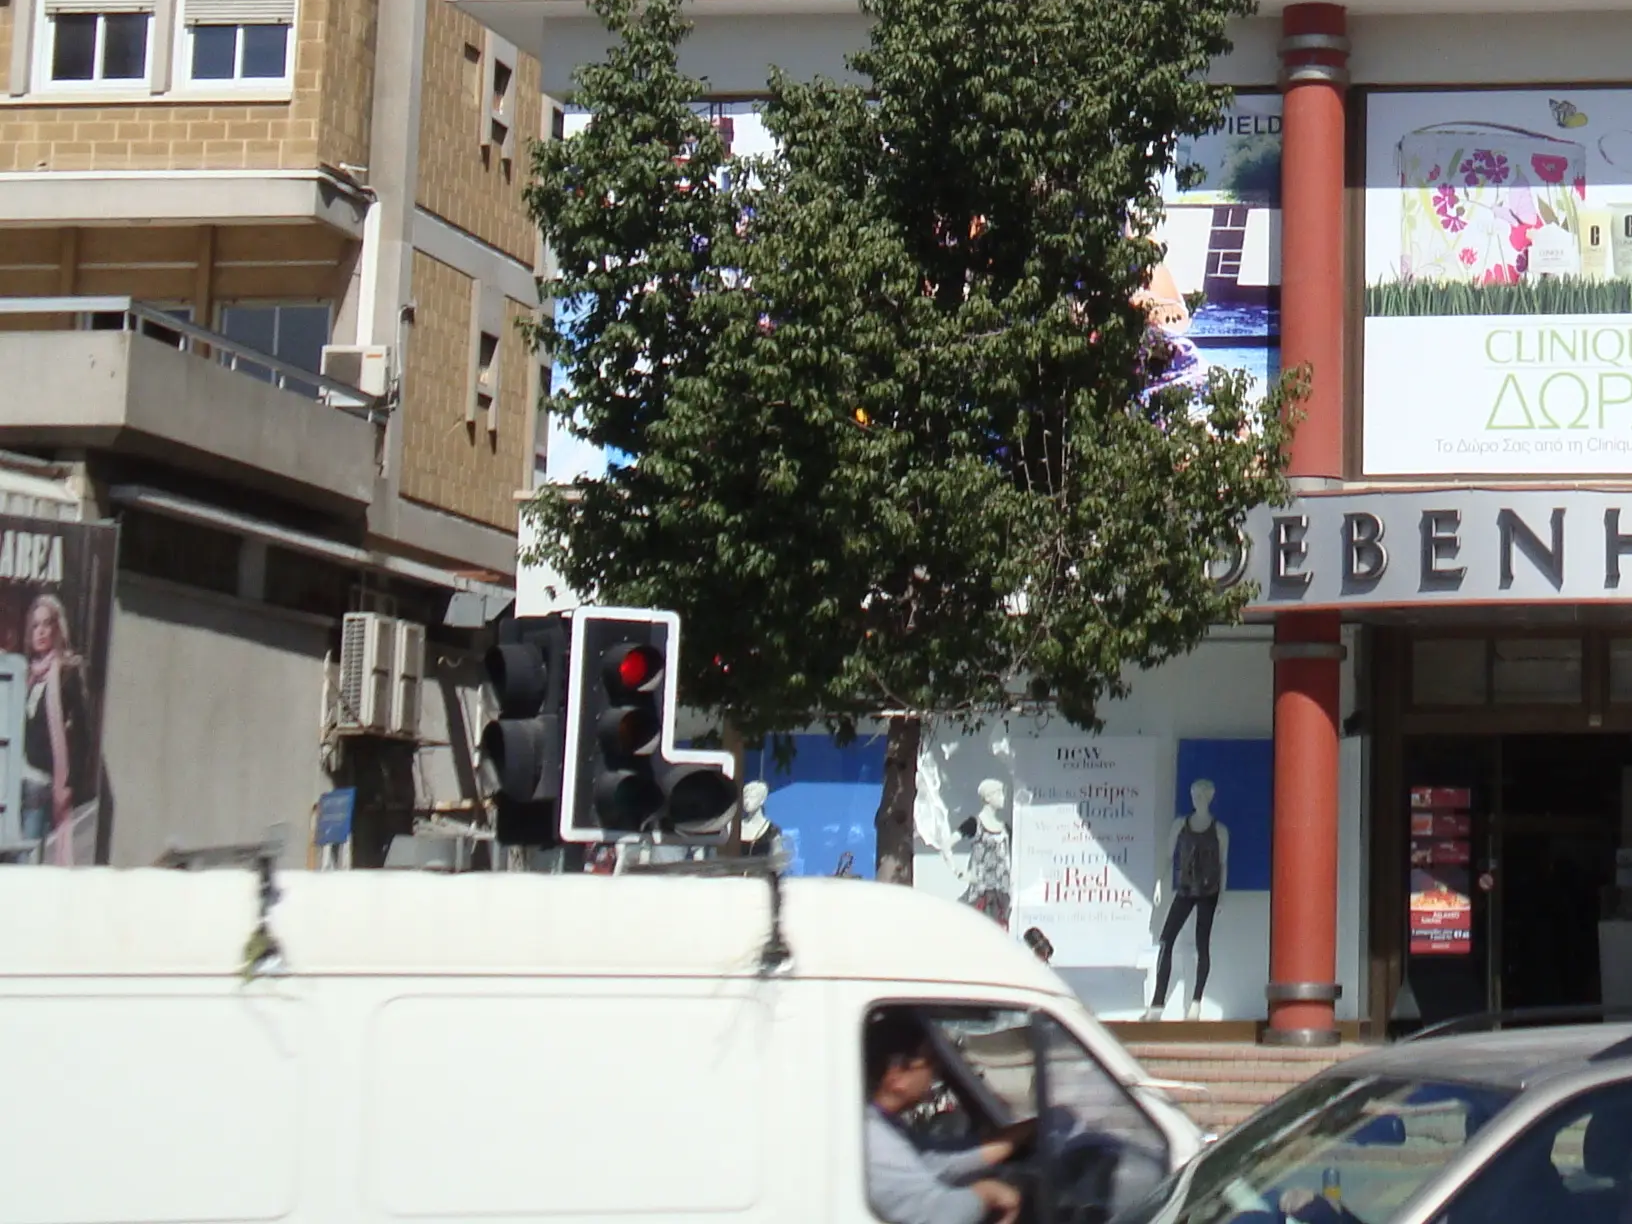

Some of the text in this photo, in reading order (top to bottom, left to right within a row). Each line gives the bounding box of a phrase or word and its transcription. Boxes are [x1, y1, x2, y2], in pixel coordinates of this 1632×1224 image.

[1057, 746, 1101, 760] new
[1080, 782, 1139, 804] stripes
[1079, 800, 1135, 818] florals
[1065, 865, 1108, 888] Red
[1044, 881, 1133, 909] Herring
